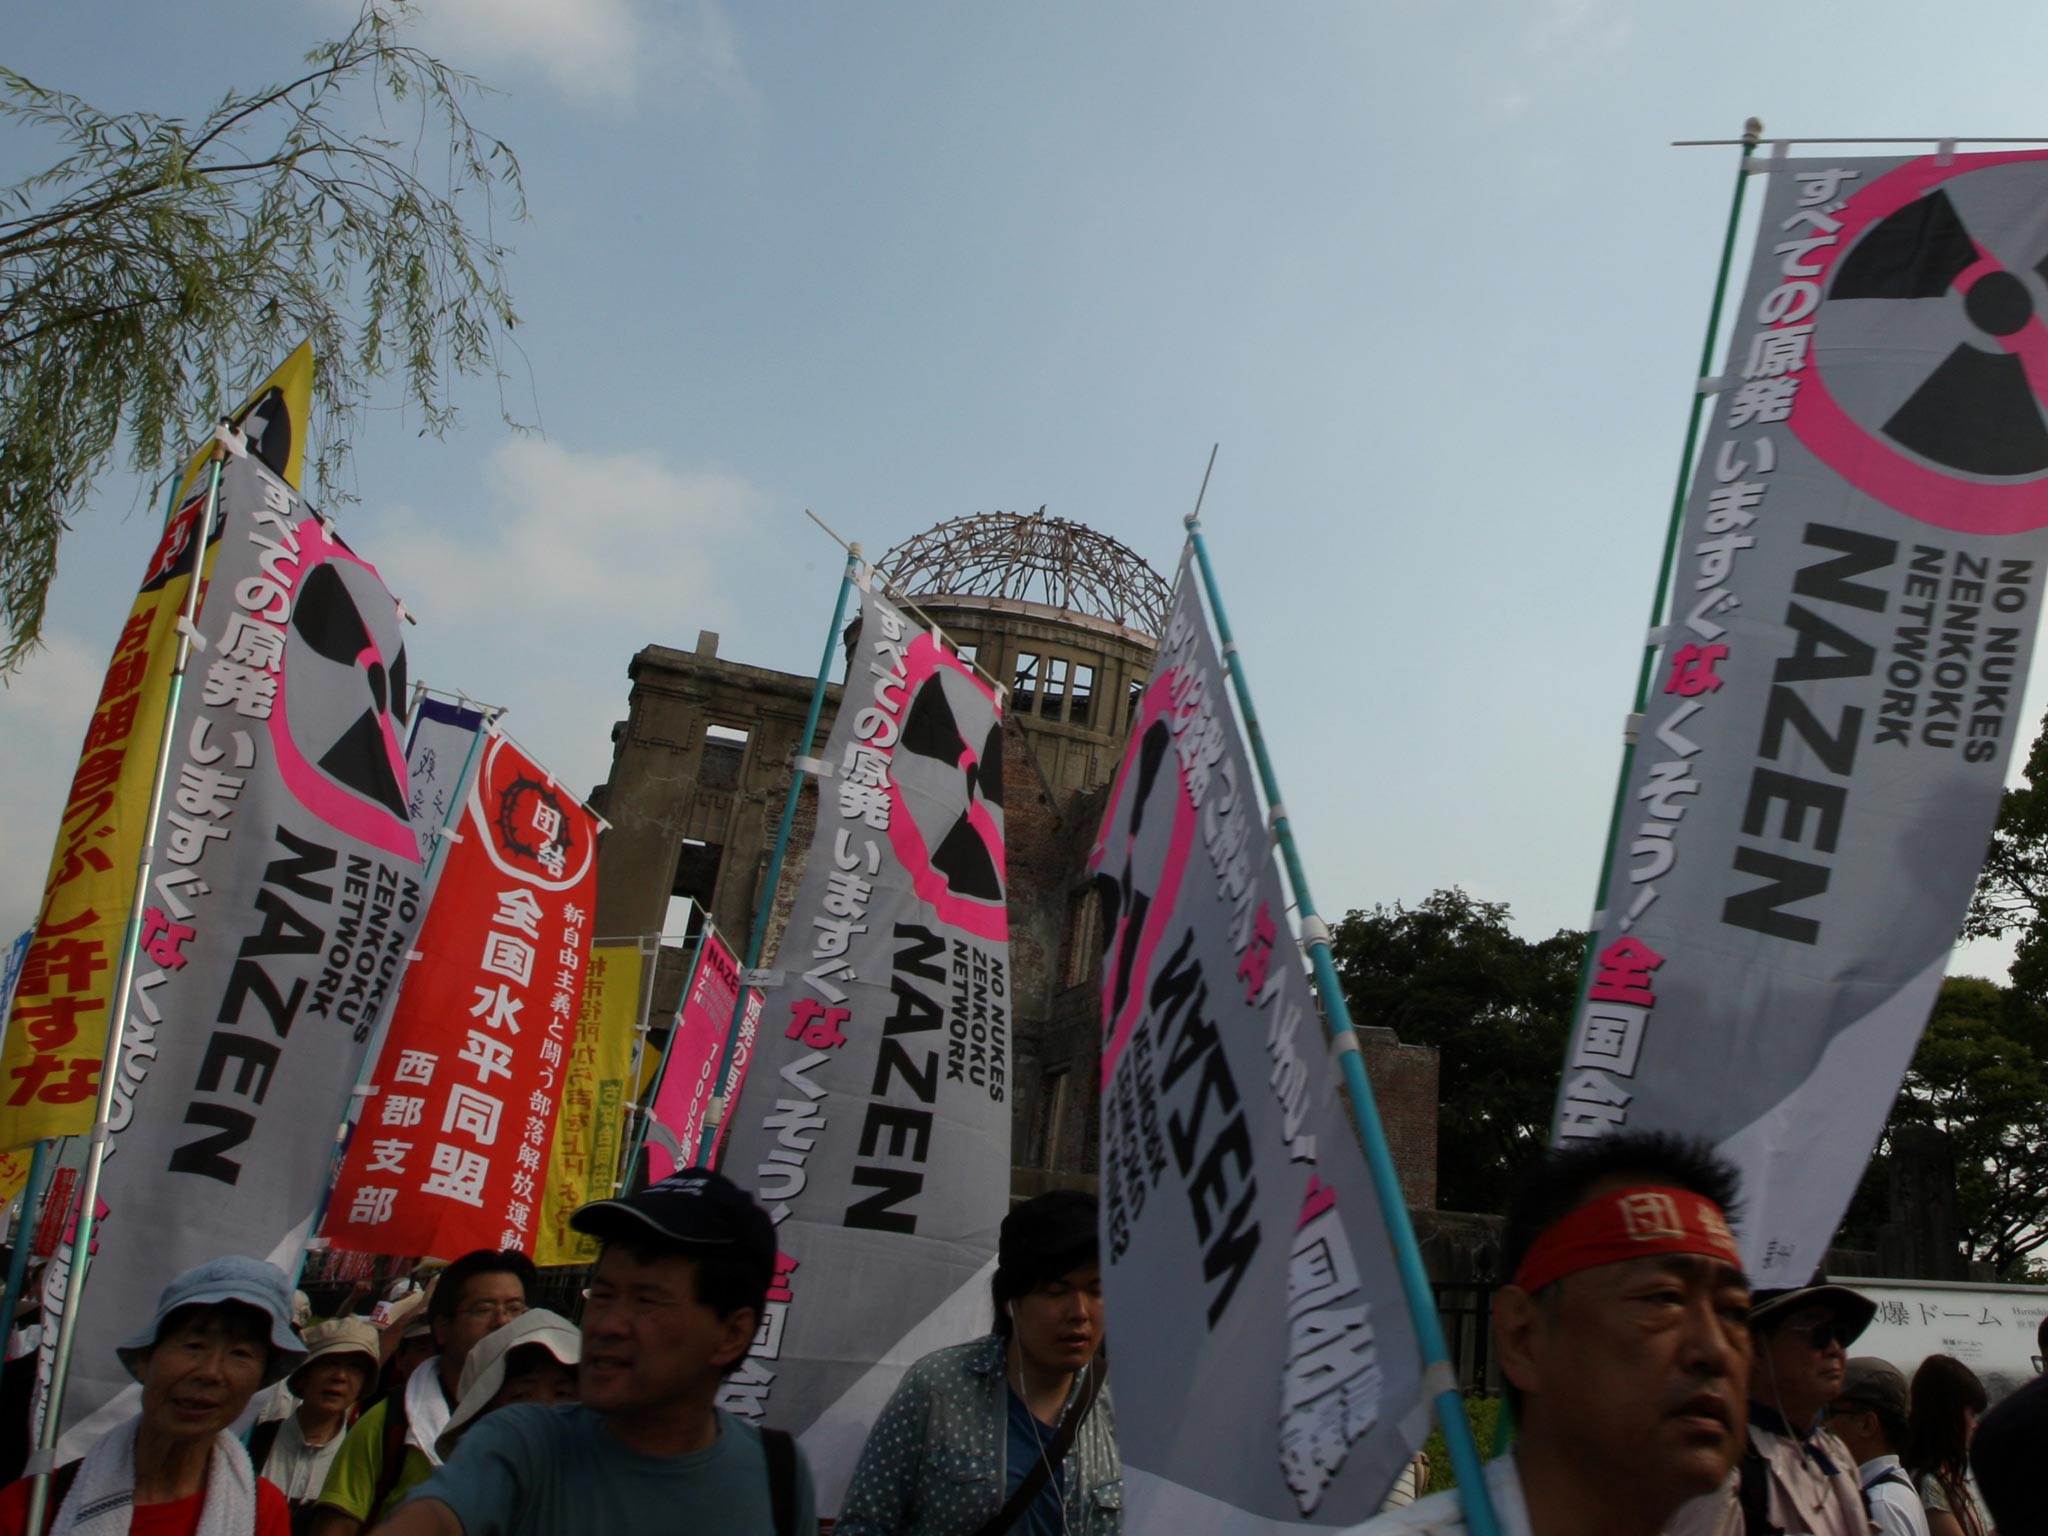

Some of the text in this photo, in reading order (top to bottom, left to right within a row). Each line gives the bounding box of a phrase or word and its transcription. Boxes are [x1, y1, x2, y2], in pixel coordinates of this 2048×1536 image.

[1874, 544, 1944, 748] NETWORK
[1922, 551, 1989, 749] ZENKOKU
[1963, 560, 2033, 763] NO NUKES
[1721, 522, 1898, 946] NAZEN
[532, 799, 566, 879] 団結
[168, 825, 338, 1186] NAZEN
[306, 854, 372, 1020] NETWORK
[336, 863, 399, 1026] ZENKOKU
[353, 877, 422, 1045] NO NUKES
[946, 940, 969, 1083] NETWORK
[968, 947, 989, 1088] ZENKOKU
[420, 887, 544, 1209] 全国水平同盟
[844, 922, 947, 1235] NAZEN
[989, 957, 1006, 1103] NO NUKES
[348, 1049, 438, 1225] 西郡支部
[1872, 1301, 2003, 1327] 爆ドーム
